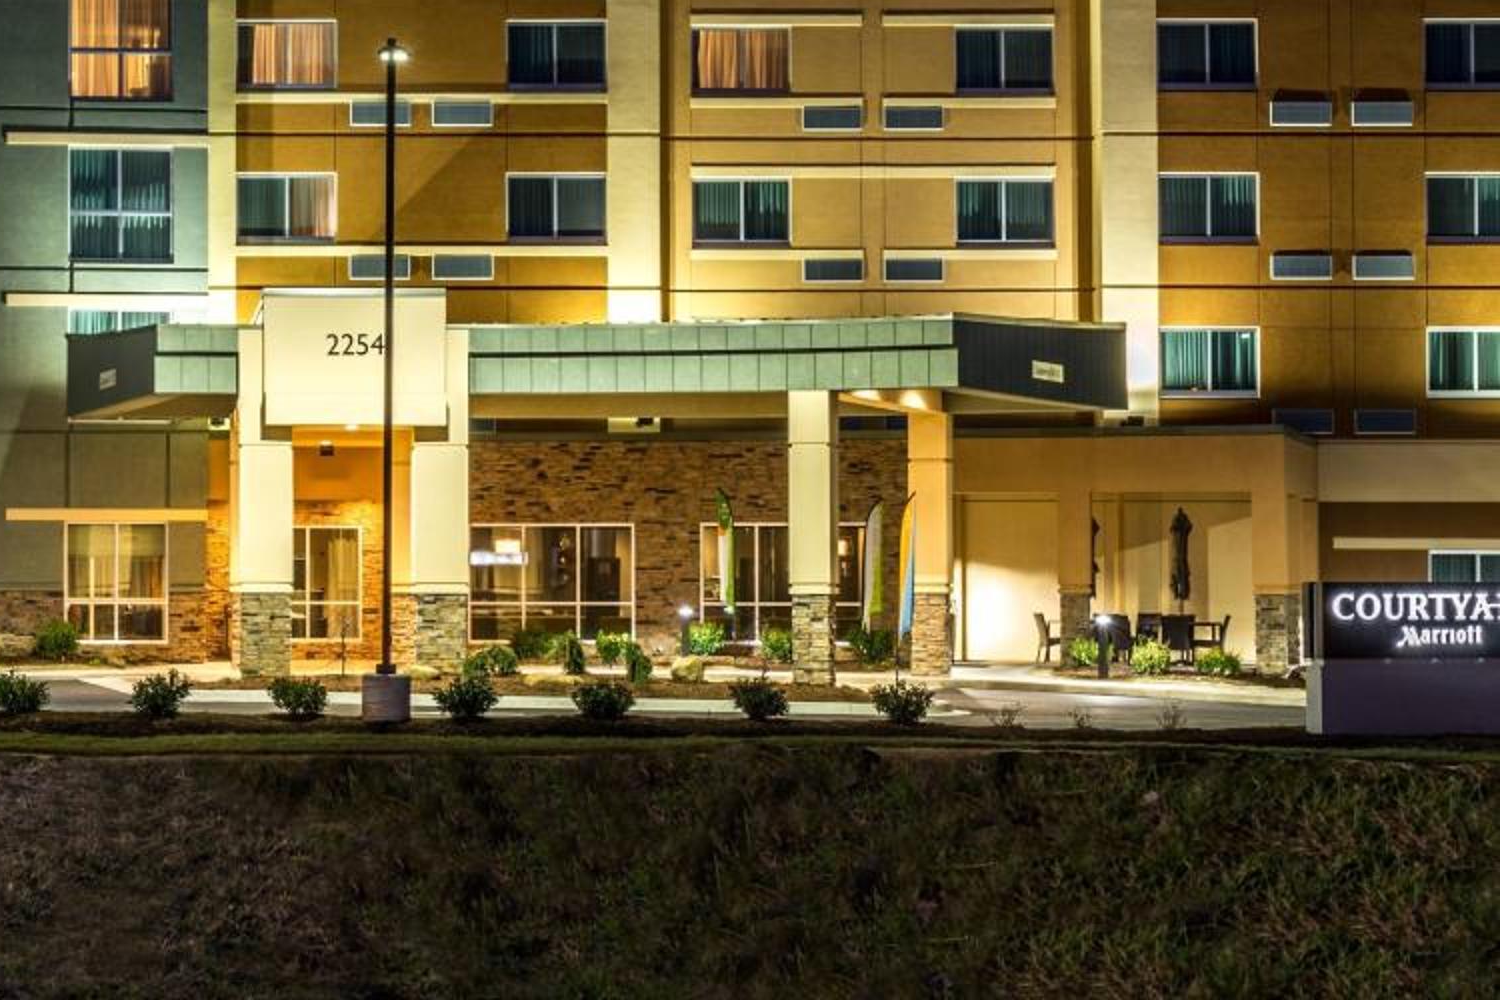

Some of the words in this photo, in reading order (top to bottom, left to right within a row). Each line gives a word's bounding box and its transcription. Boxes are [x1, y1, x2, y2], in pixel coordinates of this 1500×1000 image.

[326, 333, 386, 356] 2254
[1331, 592, 1500, 621] COURTYA
[1395, 625, 1483, 648] Marriott
